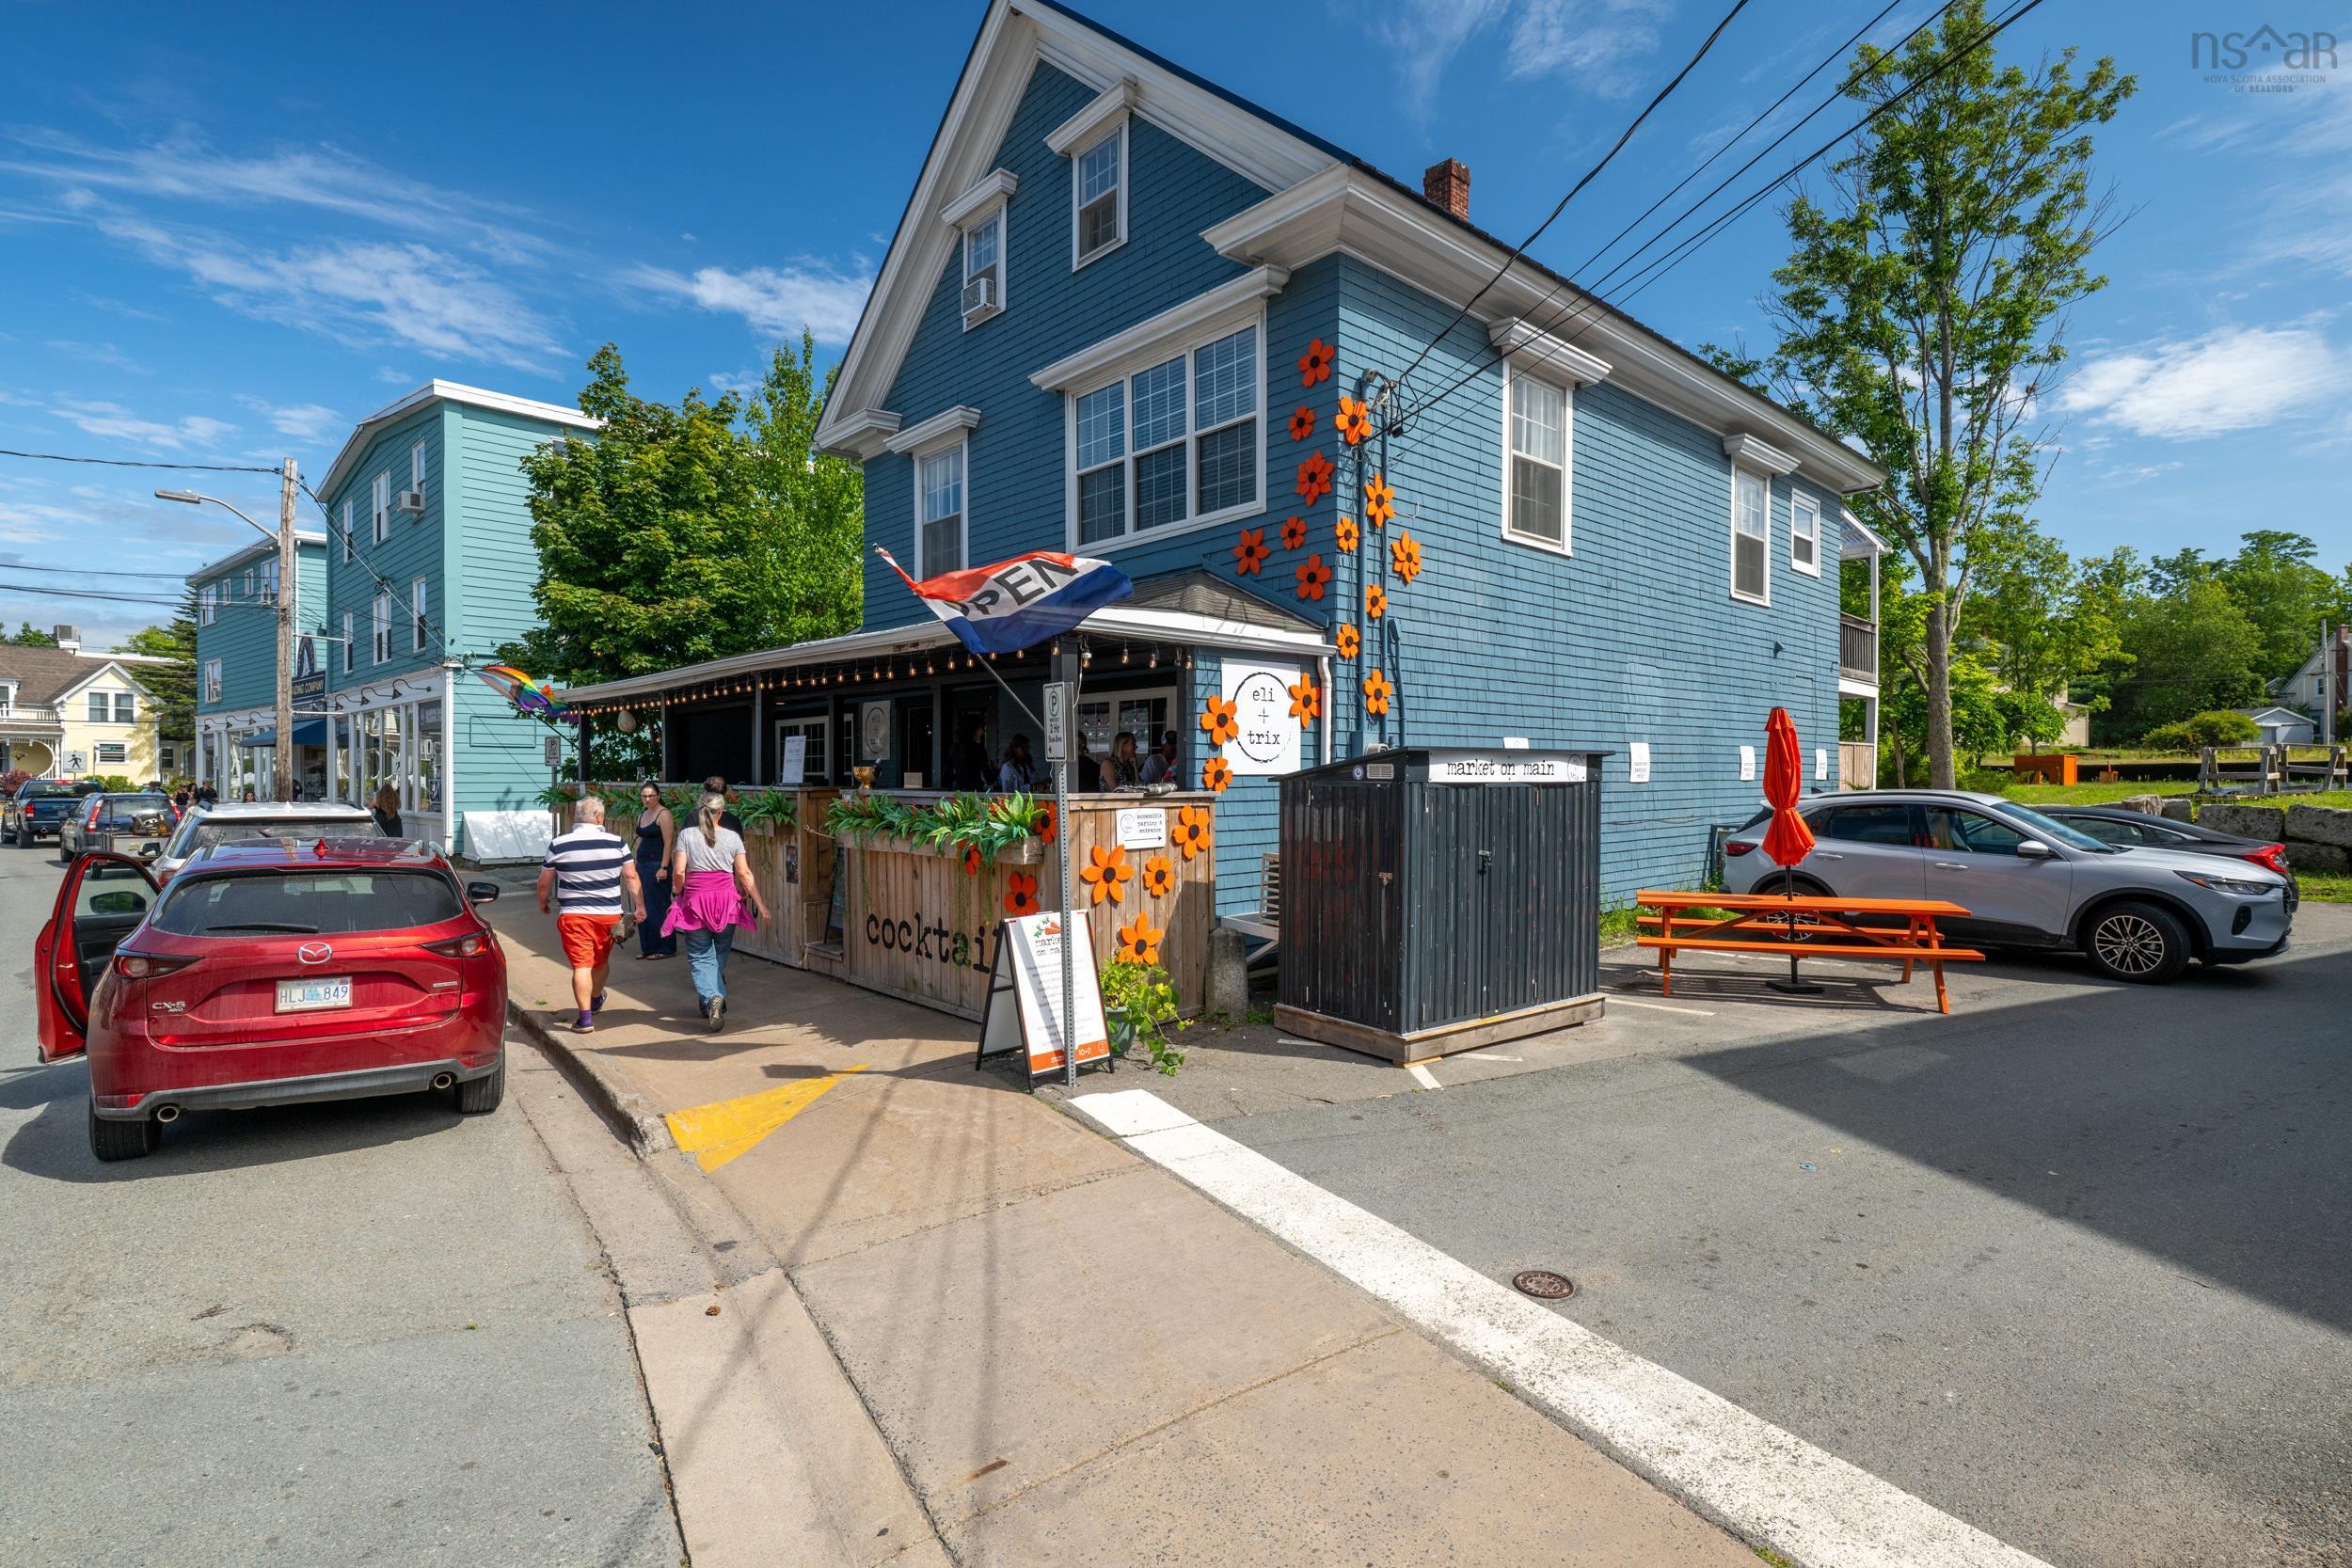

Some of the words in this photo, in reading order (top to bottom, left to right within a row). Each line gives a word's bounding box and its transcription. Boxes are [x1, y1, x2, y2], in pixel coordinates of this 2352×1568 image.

[305, 678, 324, 693] COMPANY
[1252, 687, 1275, 702] eli
[1052, 695, 1057, 712] P
[1248, 730, 1280, 745] trix
[1447, 758, 1495, 776] market
[1501, 764, 1516, 775] on
[1523, 759, 1555, 776] main
[866, 911, 999, 974] cocktai
[1035, 936, 1062, 946] marke
[279, 989, 305, 1004] HLJ
[324, 986, 348, 1000] 849
[151, 1001, 185, 1009] CX-5
